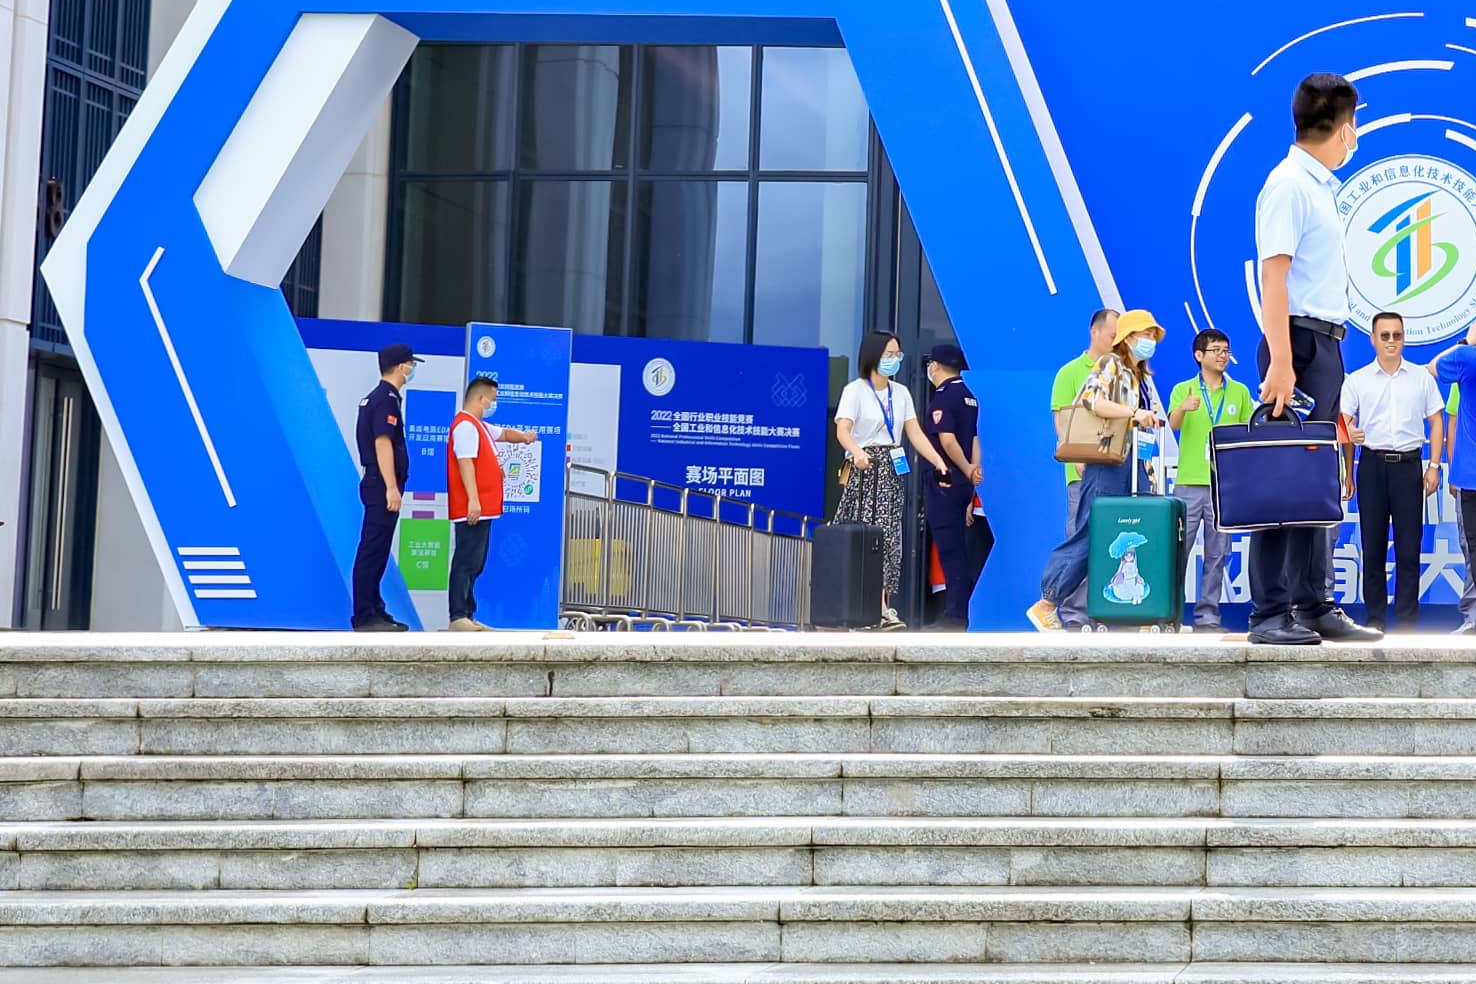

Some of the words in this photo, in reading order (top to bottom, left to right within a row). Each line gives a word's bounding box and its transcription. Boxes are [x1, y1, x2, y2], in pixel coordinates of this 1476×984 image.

[650, 410, 671, 421] 2022
[685, 465, 765, 487] 赛场平面图
[729, 488, 752, 497] PLAN
